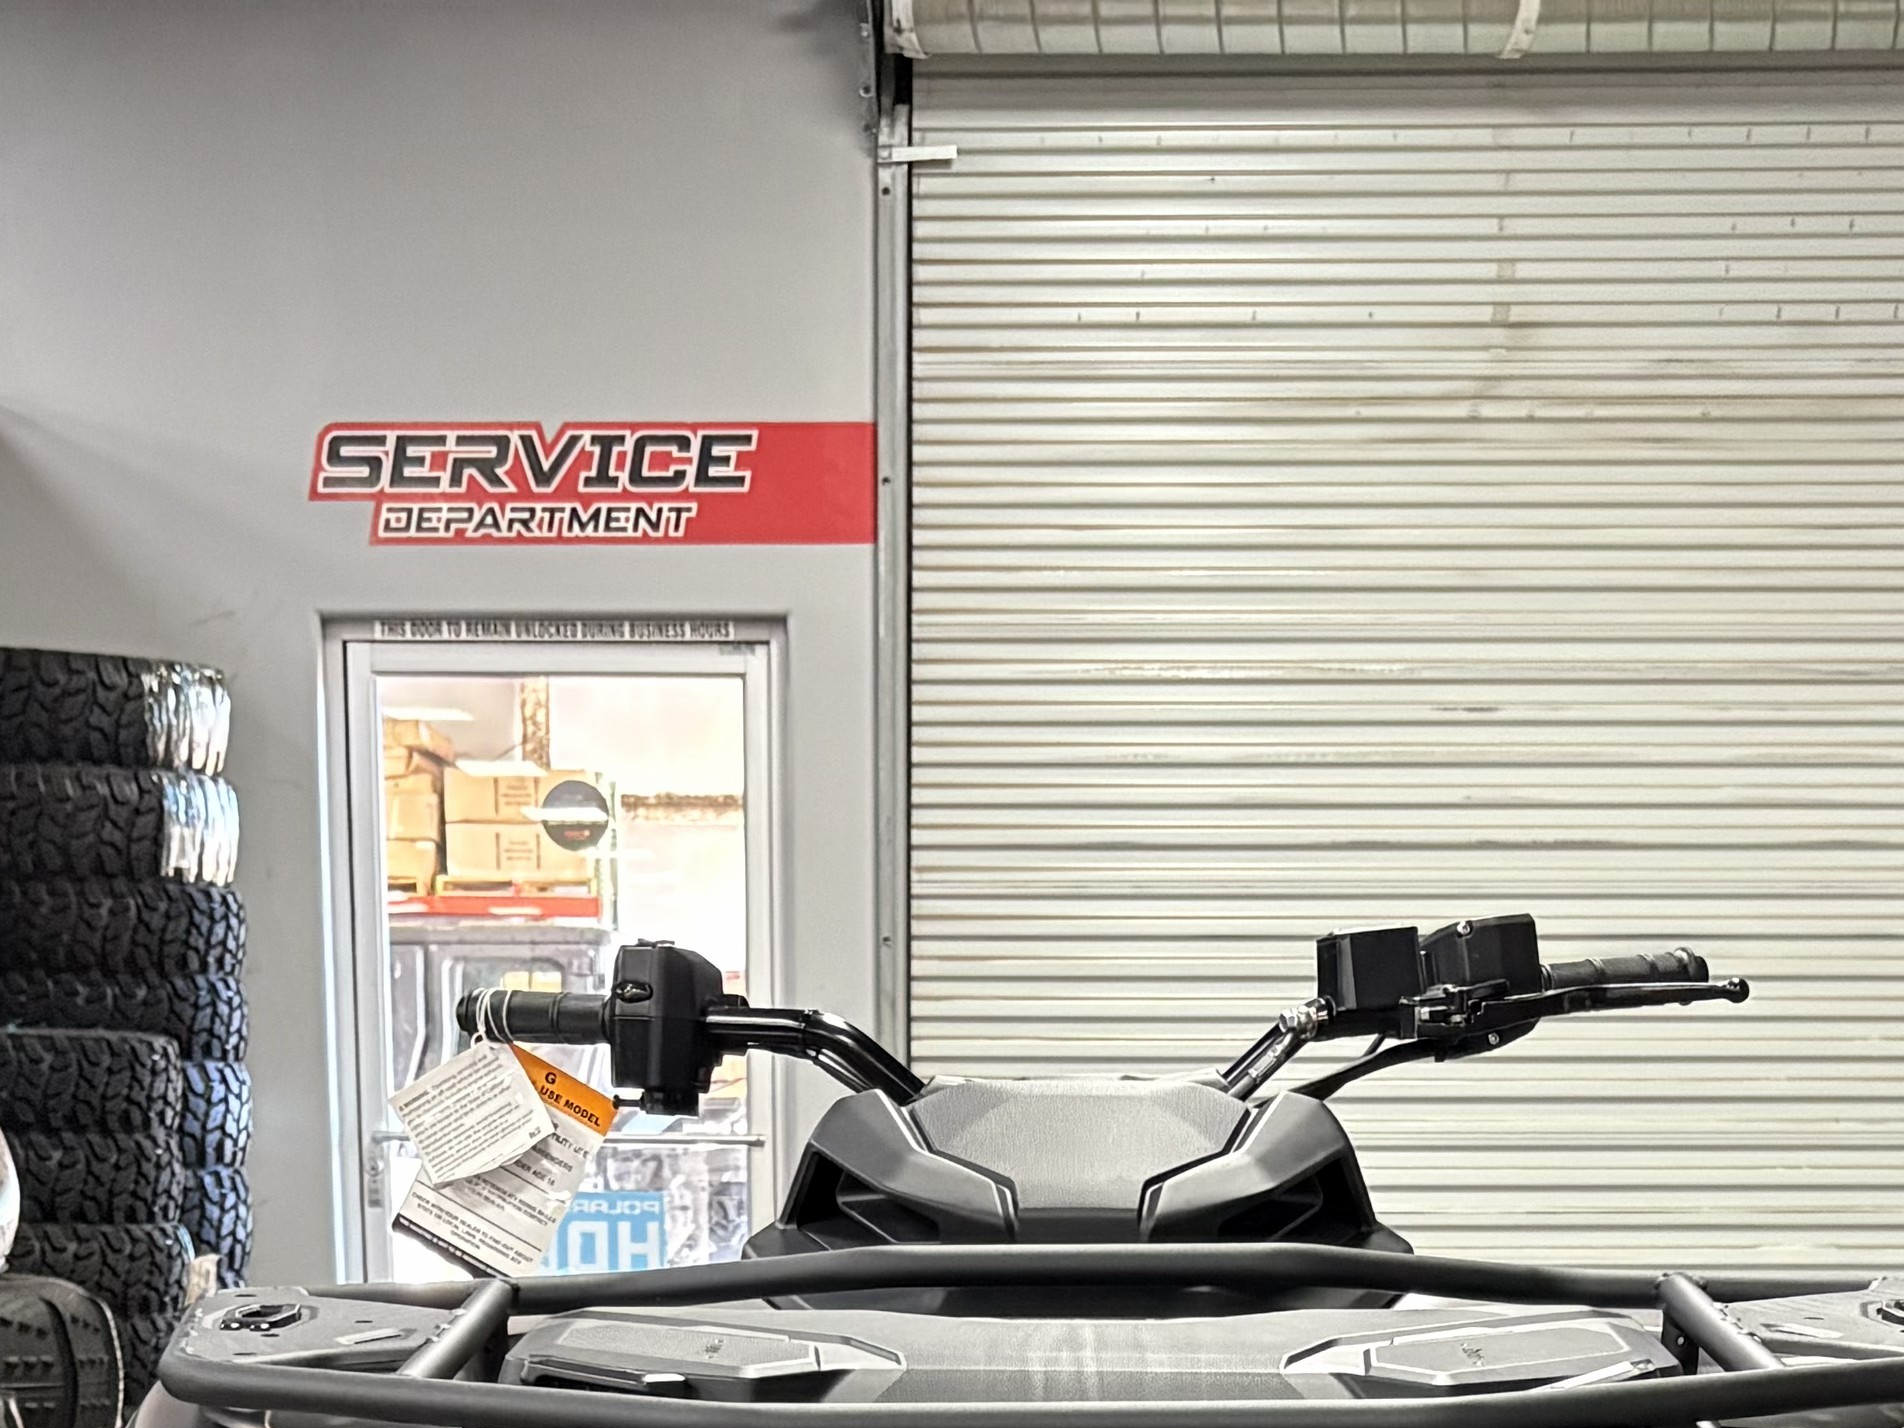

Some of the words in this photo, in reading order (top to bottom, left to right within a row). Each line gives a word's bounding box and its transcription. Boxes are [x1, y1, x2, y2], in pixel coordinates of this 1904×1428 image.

[320, 431, 756, 491] SERVICE
[379, 503, 696, 537] DEPARTMENT
[540, 1084, 564, 1106] USE
[563, 1097, 602, 1128] MODEL
